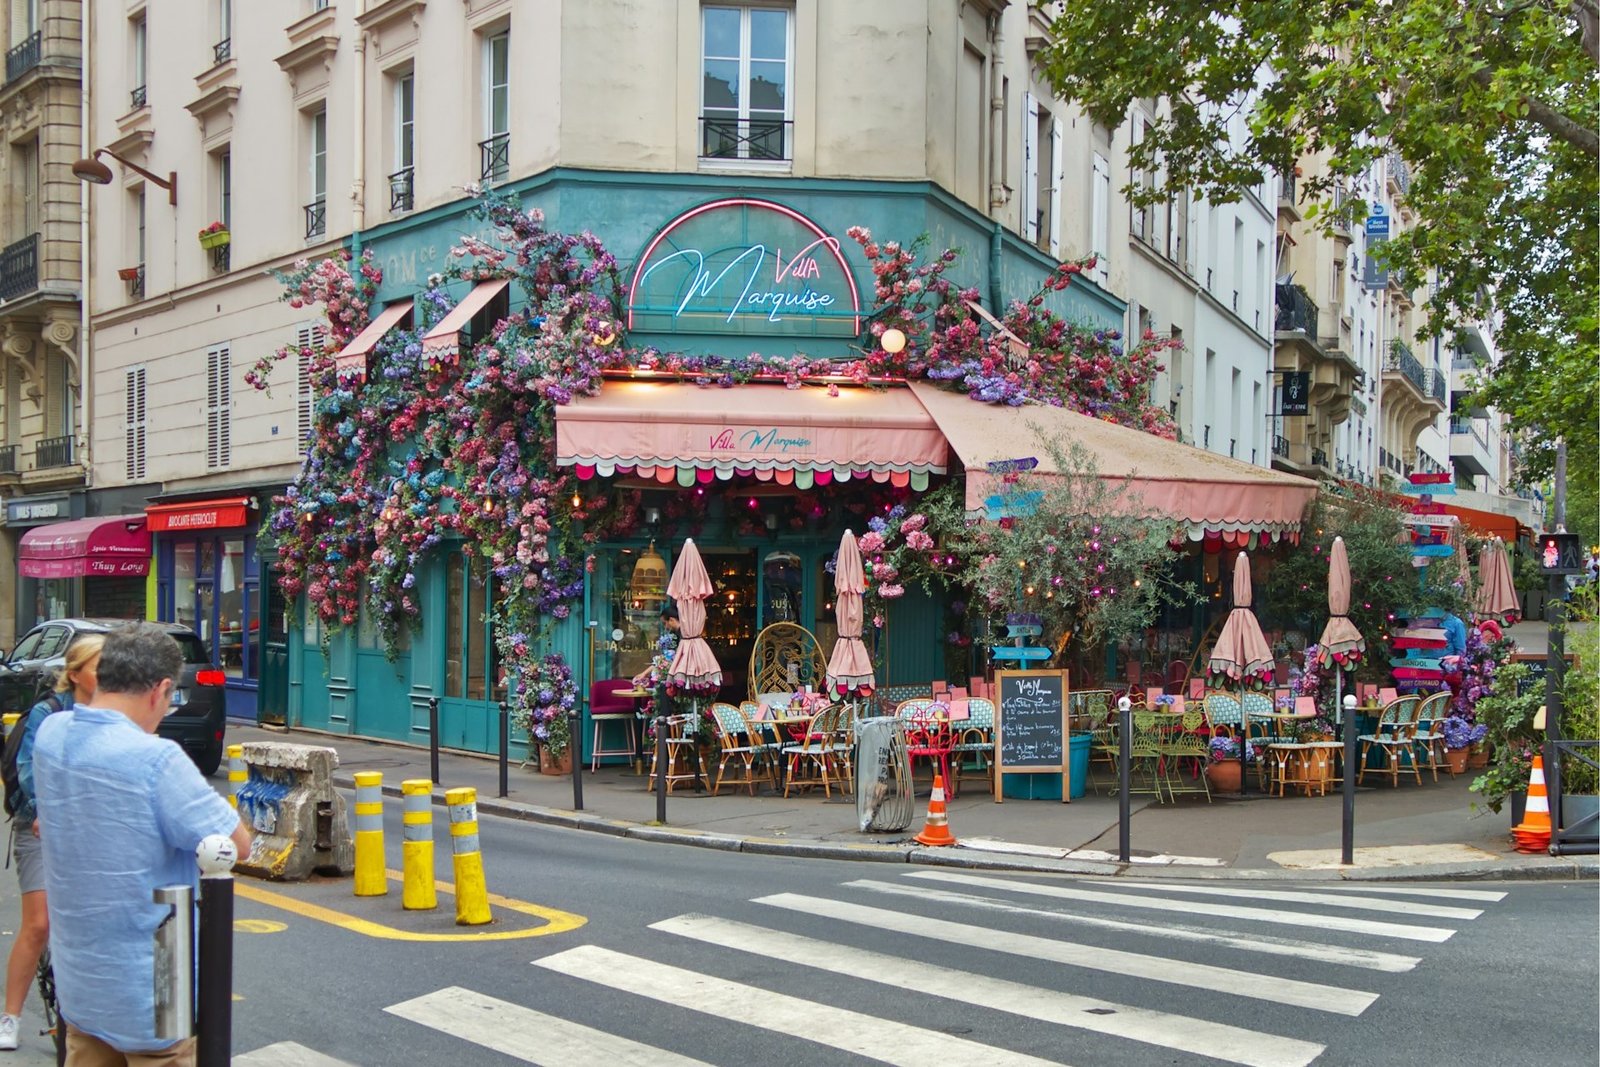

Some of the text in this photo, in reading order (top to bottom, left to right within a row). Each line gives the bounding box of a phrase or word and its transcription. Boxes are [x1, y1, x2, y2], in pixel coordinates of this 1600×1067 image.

[641, 244, 835, 324] Marquise
[709, 428, 812, 452] Villa Marquise
[92, 561, 116, 573] Thuy
[120, 562, 144, 573] Long
